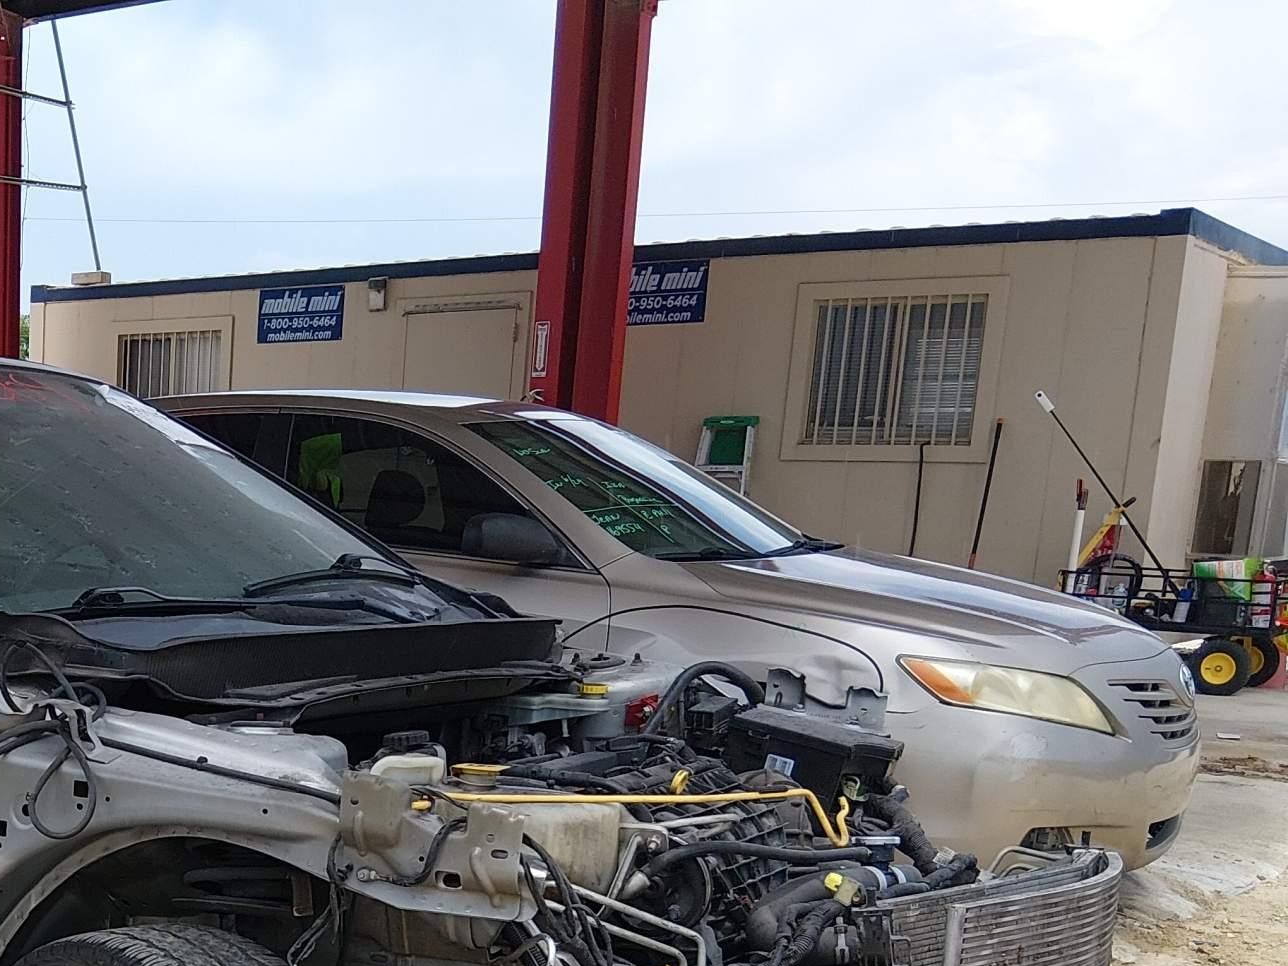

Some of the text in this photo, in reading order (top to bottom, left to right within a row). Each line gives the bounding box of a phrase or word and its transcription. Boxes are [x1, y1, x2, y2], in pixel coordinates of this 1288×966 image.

[628, 265, 704, 292] bile mini
[261, 289, 343, 314] mobile mini
[627, 295, 697, 310] 0-950-6464
[263, 316, 337, 330] 1-800-950-6464
[625, 310, 691, 324] ilemini.com
[266, 329, 332, 342] mobilemini.com
